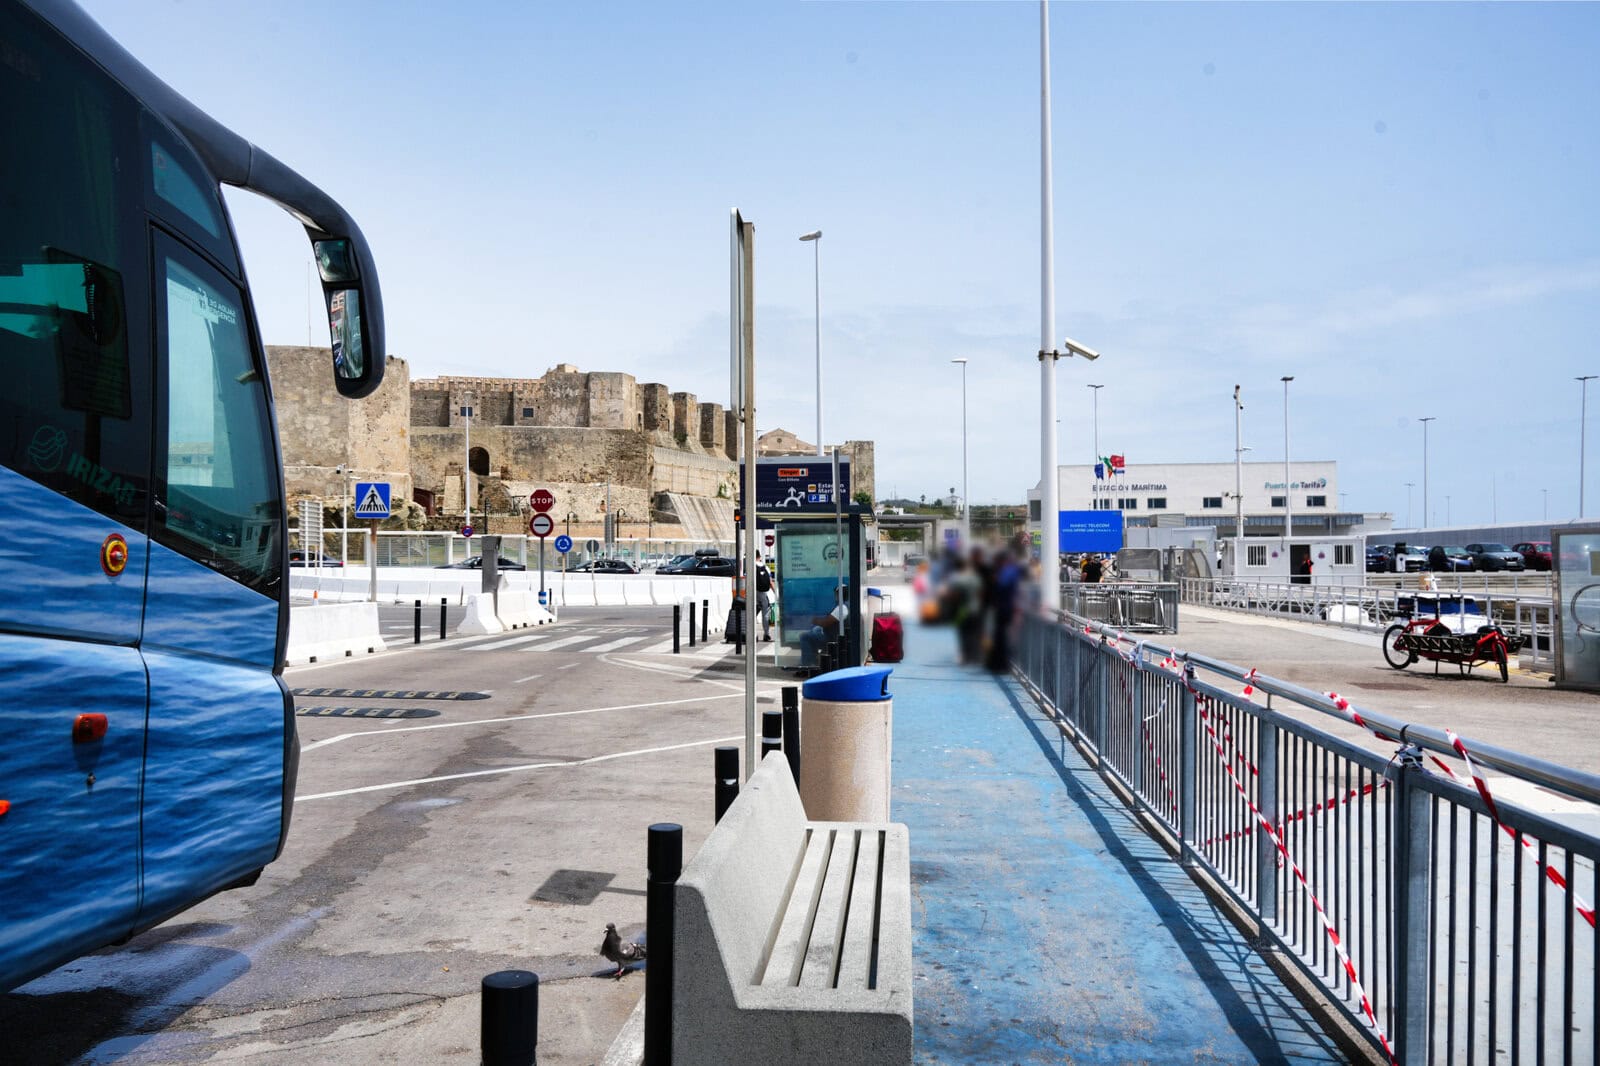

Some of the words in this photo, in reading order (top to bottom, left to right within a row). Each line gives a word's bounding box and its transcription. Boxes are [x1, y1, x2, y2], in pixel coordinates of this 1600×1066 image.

[67, 450, 137, 506] IRIZAR
[1300, 481, 1321, 489] Tarifa
[531, 497, 553, 505] STOP
